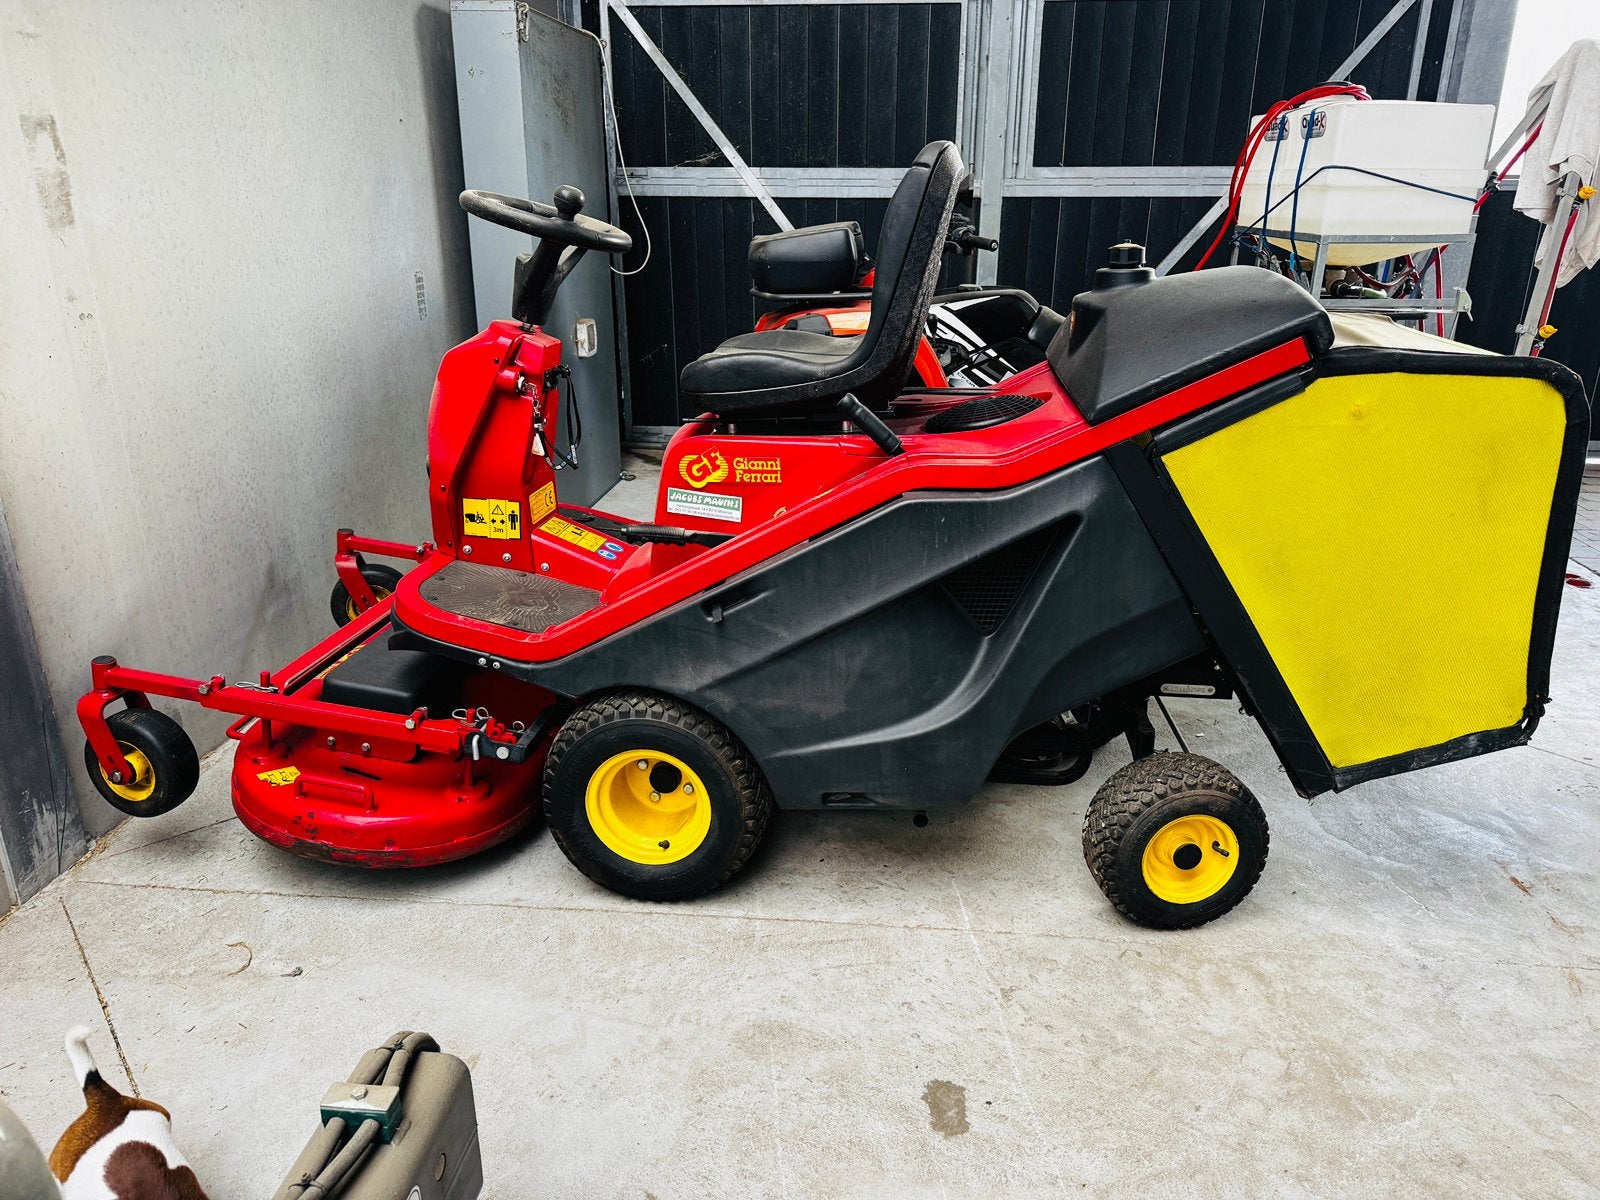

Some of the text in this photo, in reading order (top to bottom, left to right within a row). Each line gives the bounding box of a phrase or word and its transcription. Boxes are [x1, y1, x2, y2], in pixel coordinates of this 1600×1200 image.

[733, 457, 781, 471] Gianni
[735, 470, 782, 483] Ferrari
[670, 492, 702, 503] JACOBS
